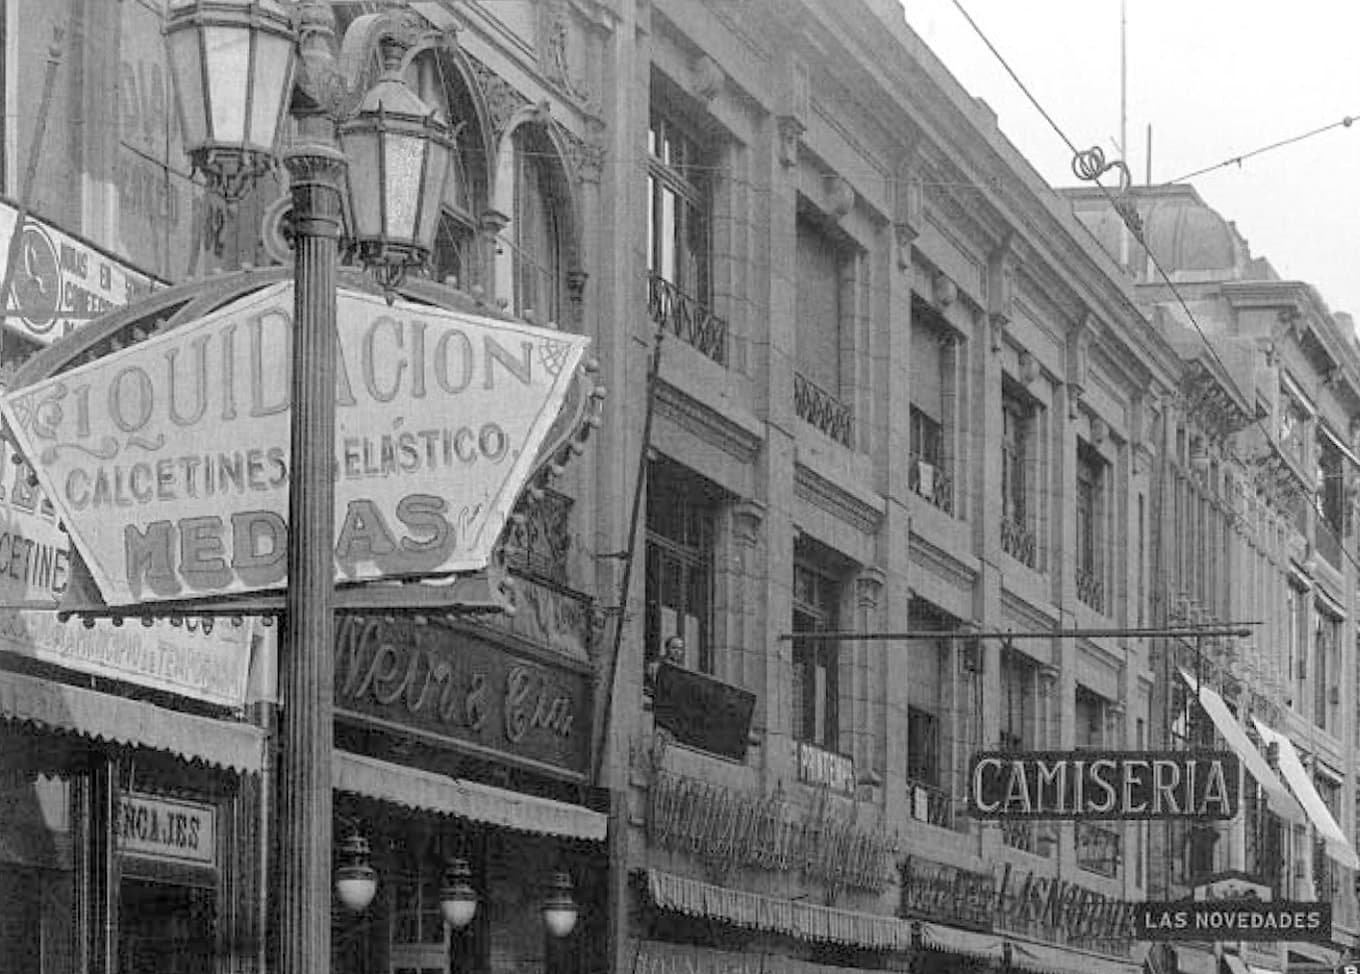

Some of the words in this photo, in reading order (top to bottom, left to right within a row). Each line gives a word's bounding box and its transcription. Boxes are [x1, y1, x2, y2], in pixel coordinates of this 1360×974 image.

[65, 446, 287, 511] CALCETINES
[124, 492, 456, 600] MEDAS
[972, 757, 1232, 815] CAMISERIA
[1145, 911, 1187, 929] LAS
[1196, 911, 1321, 929] NOVEDADES
